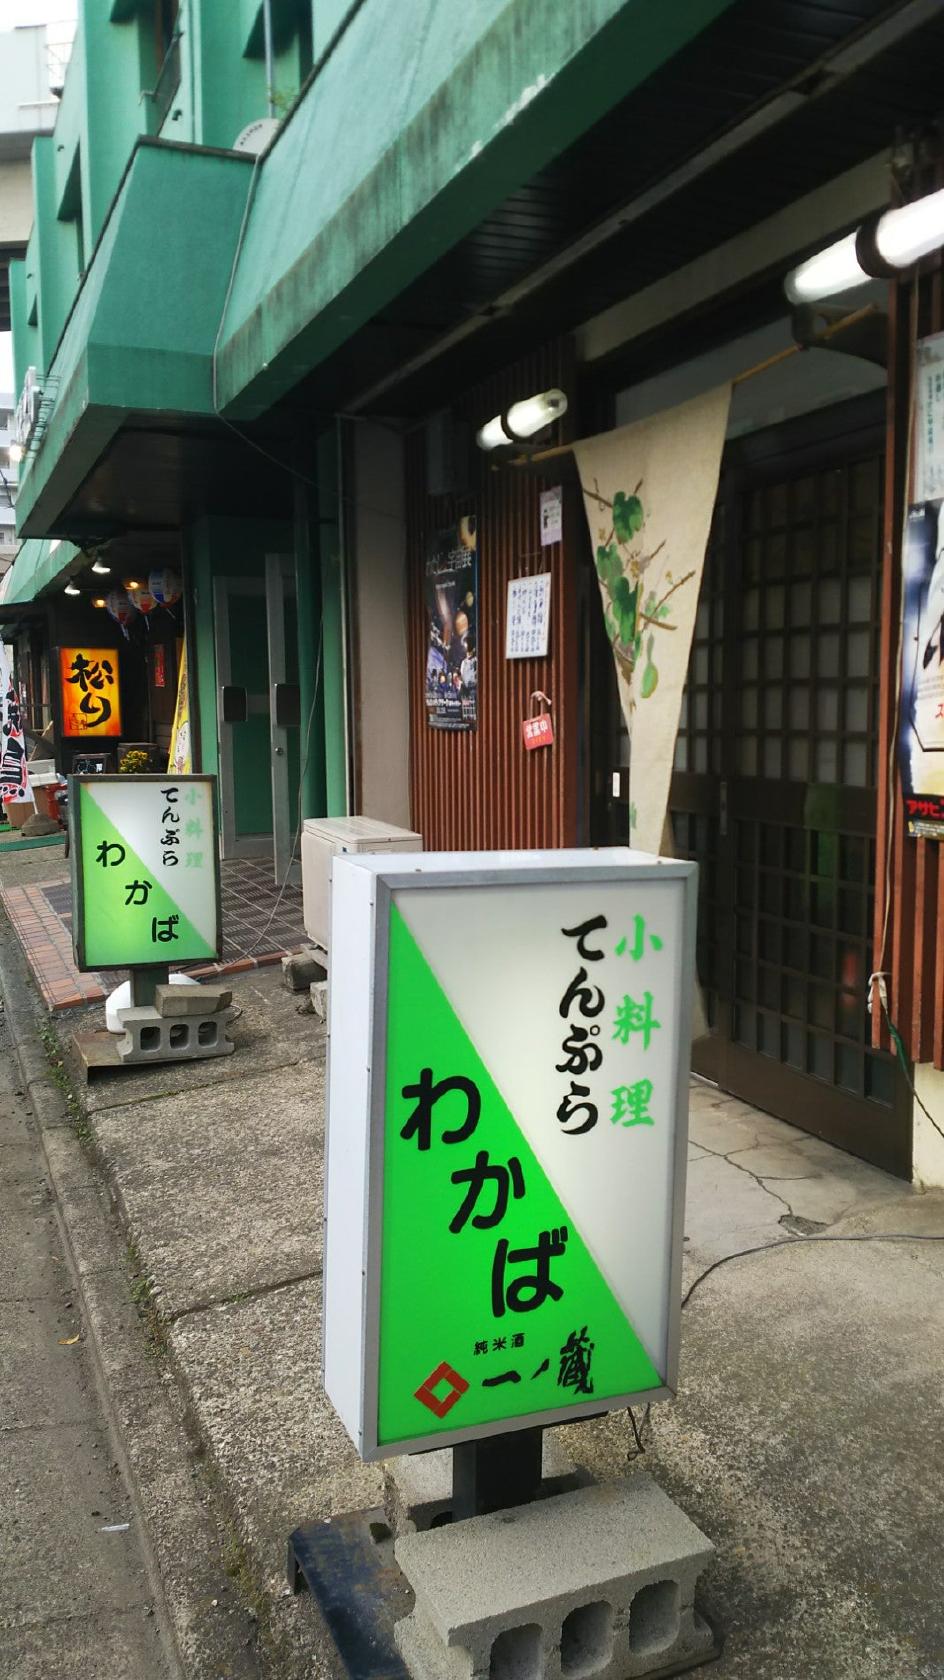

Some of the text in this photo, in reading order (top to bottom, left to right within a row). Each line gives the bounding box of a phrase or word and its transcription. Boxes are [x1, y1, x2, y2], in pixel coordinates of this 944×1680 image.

[64, 653, 114, 728] 松り
[160, 787, 180, 867] てんぷら
[96, 840, 180, 943] わかば
[555, 914, 608, 1135] てんぷら
[609, 914, 663, 1128] 小料理
[400, 1067, 568, 1318] わかば
[473, 1332, 526, 1356] 純米酒
